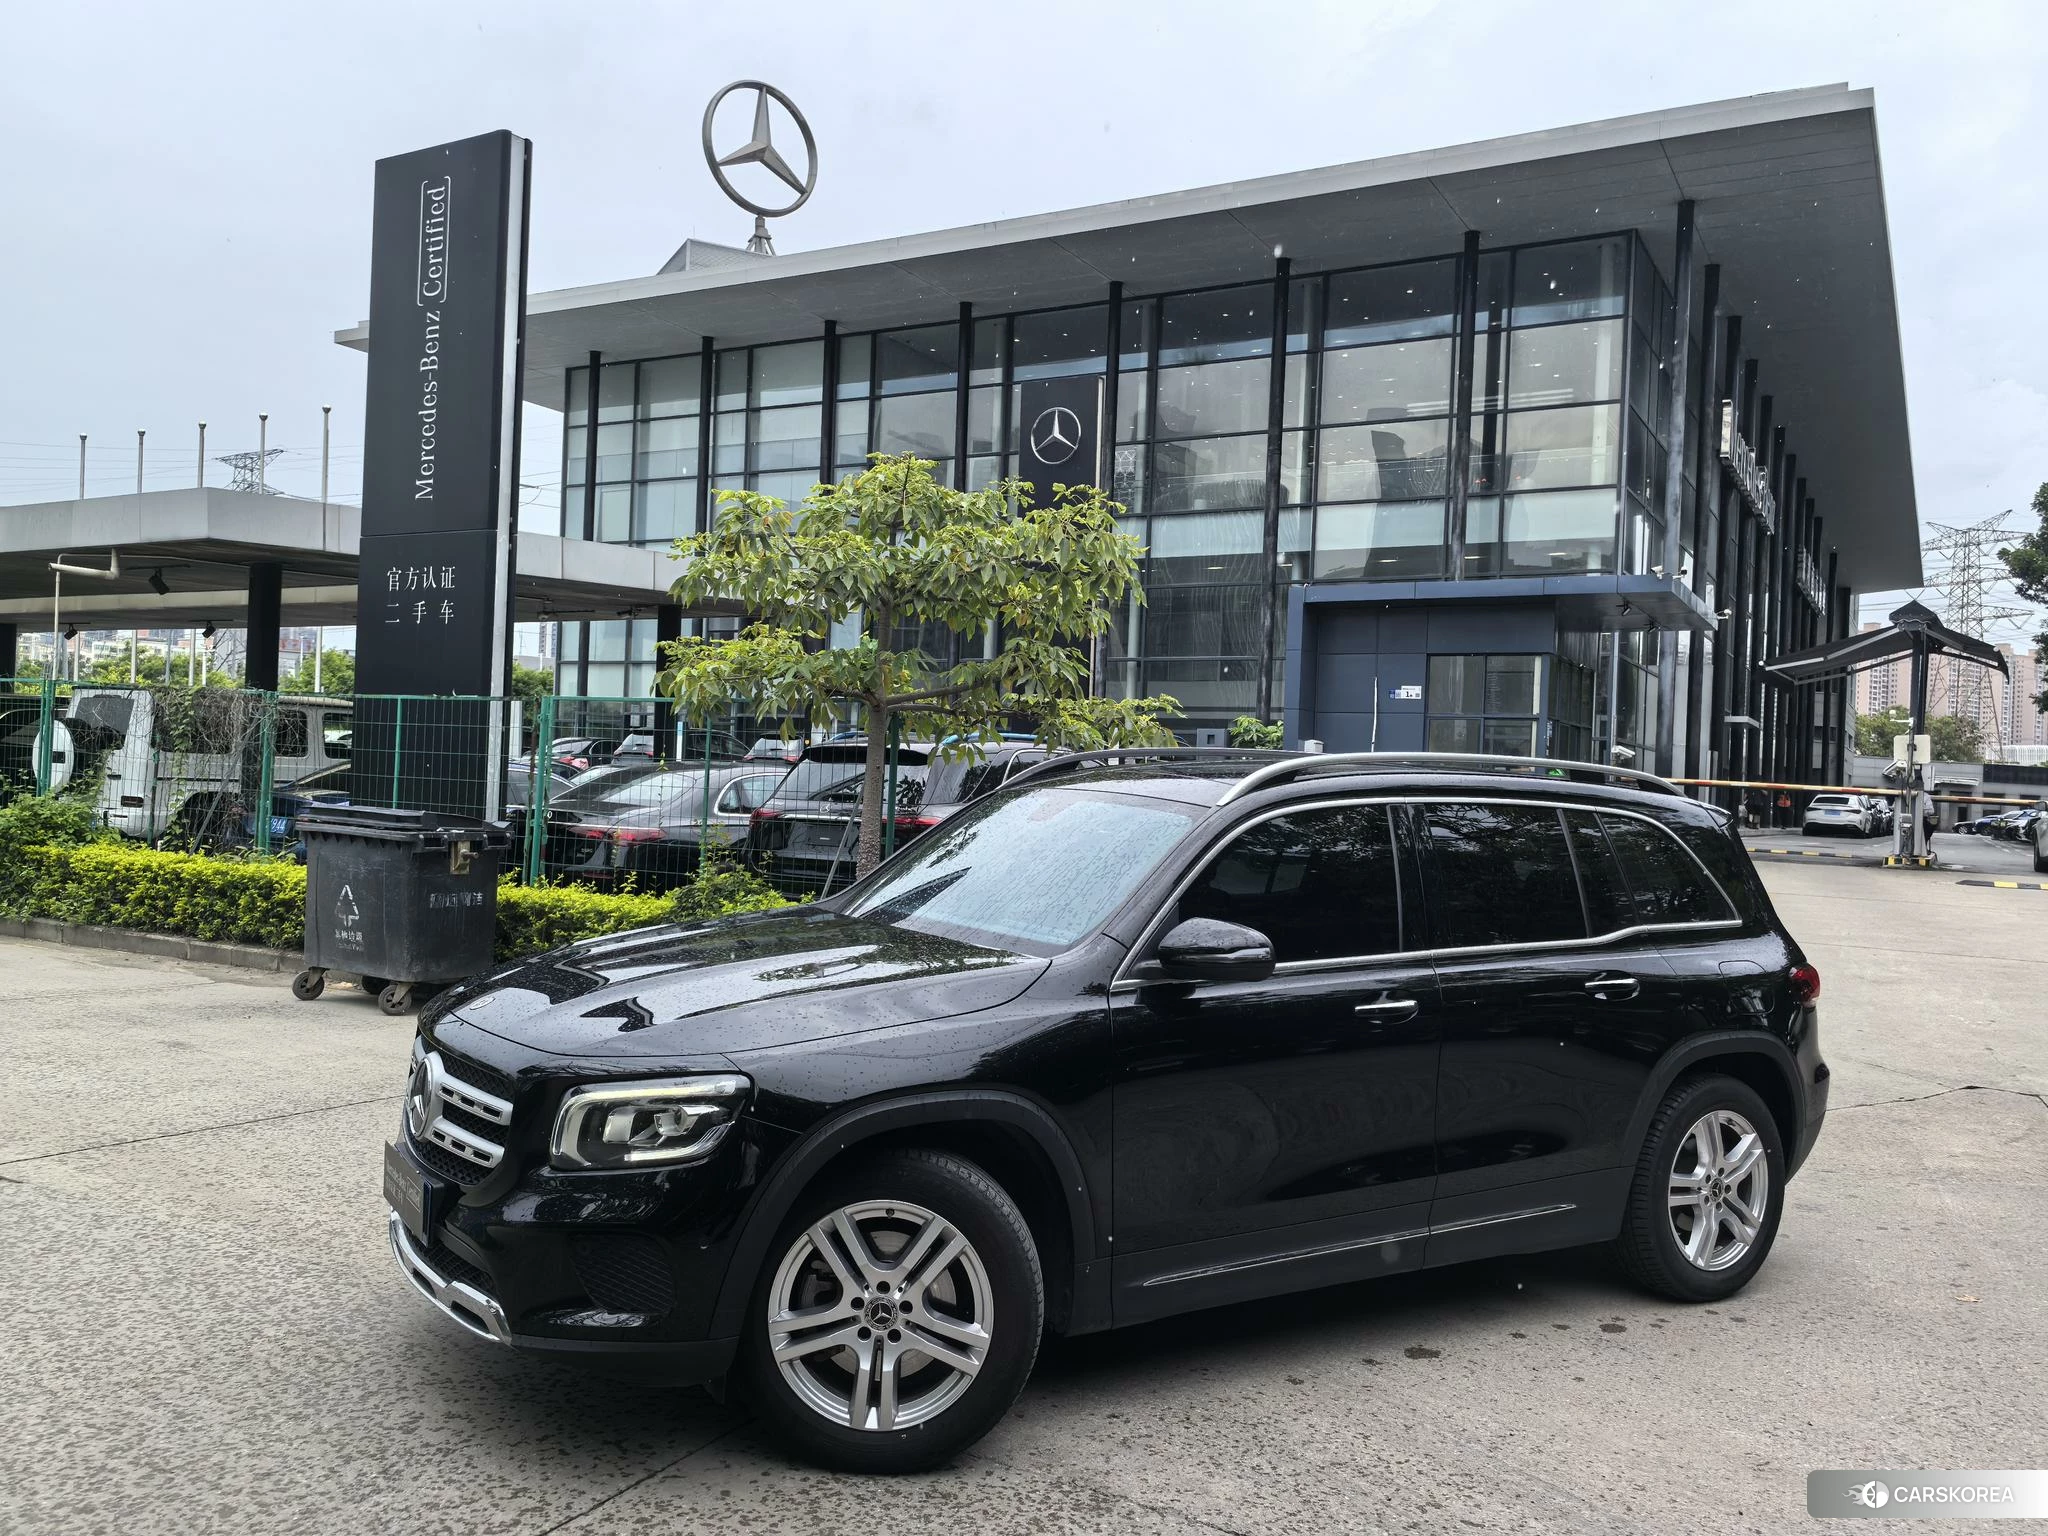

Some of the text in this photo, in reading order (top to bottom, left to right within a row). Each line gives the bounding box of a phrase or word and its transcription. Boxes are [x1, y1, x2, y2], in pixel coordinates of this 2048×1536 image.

[415, 185, 446, 501] Mercedes-Benz Certified
[387, 565, 456, 592] 官方认证
[384, 599, 454, 625] 二手车
